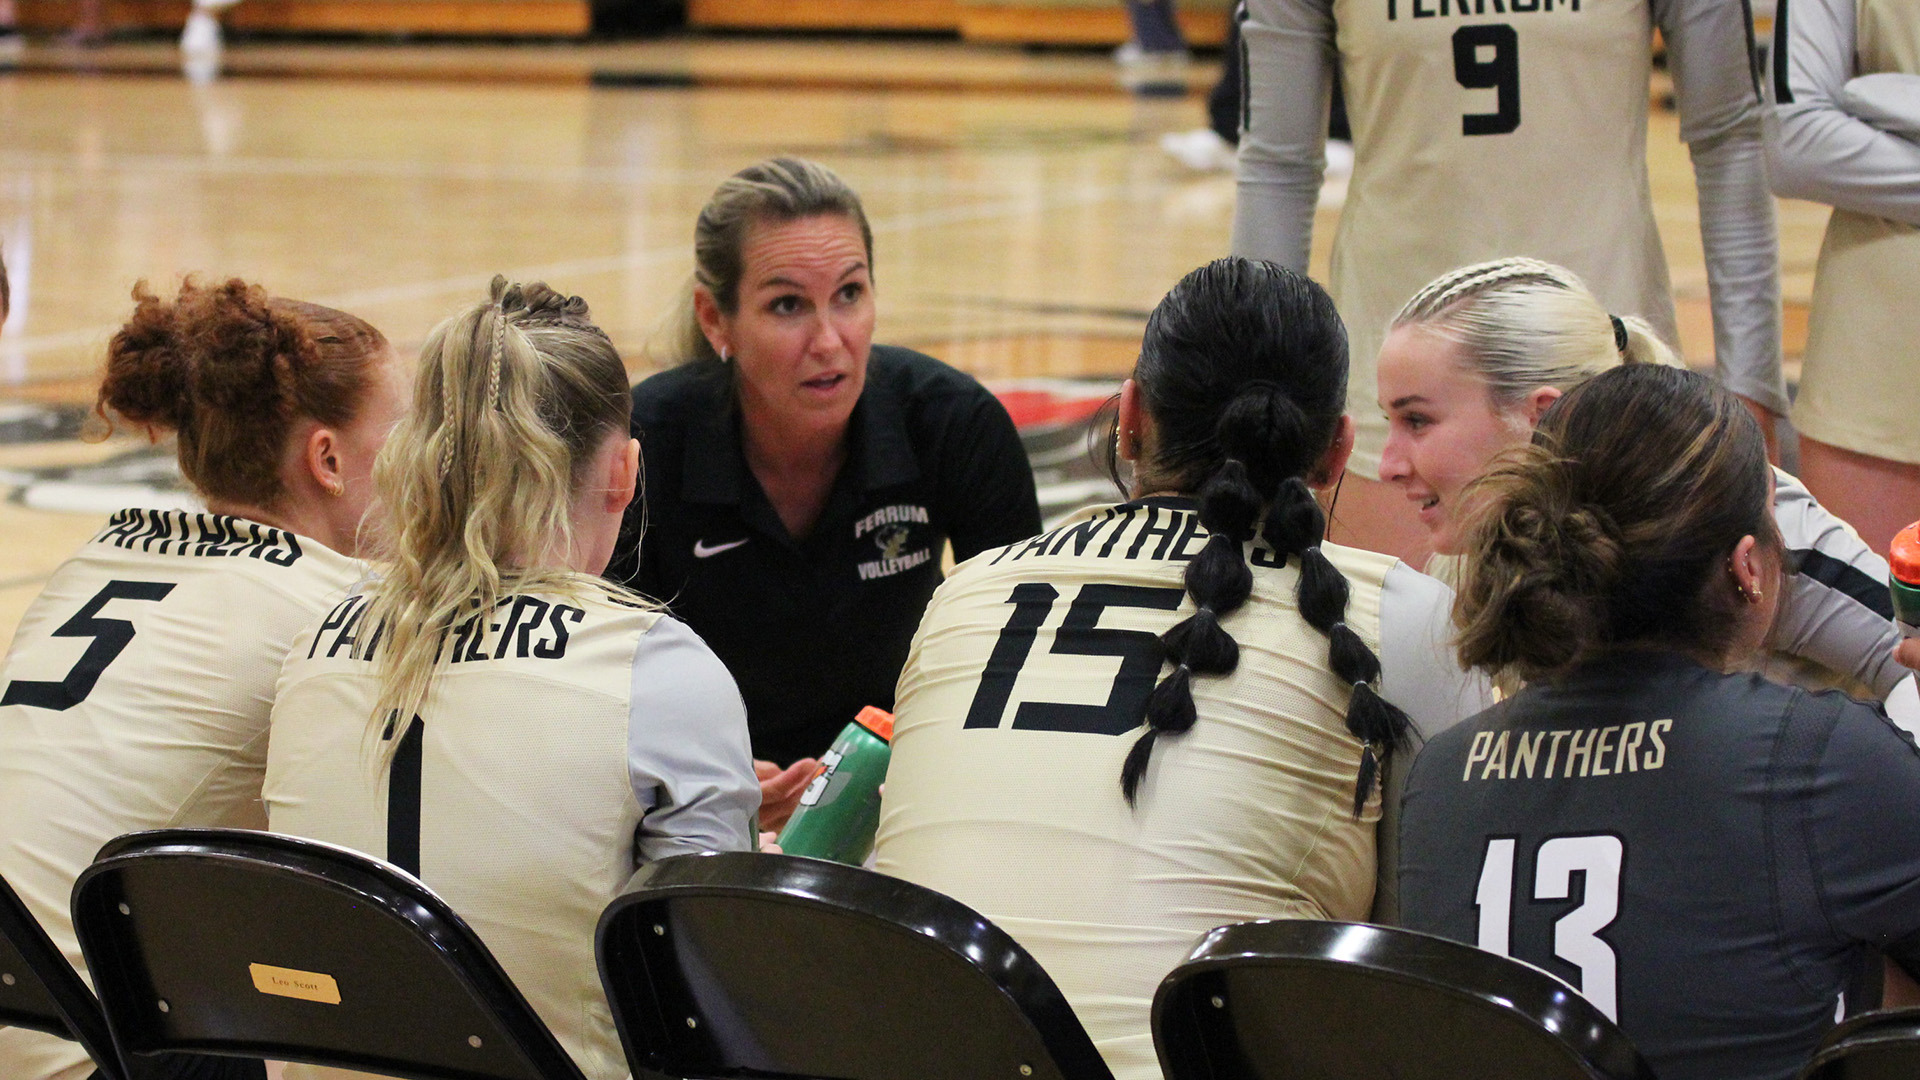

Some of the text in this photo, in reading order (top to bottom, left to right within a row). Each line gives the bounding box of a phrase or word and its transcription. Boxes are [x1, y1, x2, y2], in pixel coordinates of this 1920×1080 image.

[1452, 23, 1521, 136] 9
[856, 505, 929, 538] FERRUM
[858, 548, 931, 580] VOLLEYBALL
[0, 580, 178, 711] 5
[963, 583, 1186, 736] 15
[1463, 719, 1673, 781] PANTHERS
[1475, 835, 1623, 1025] 13
